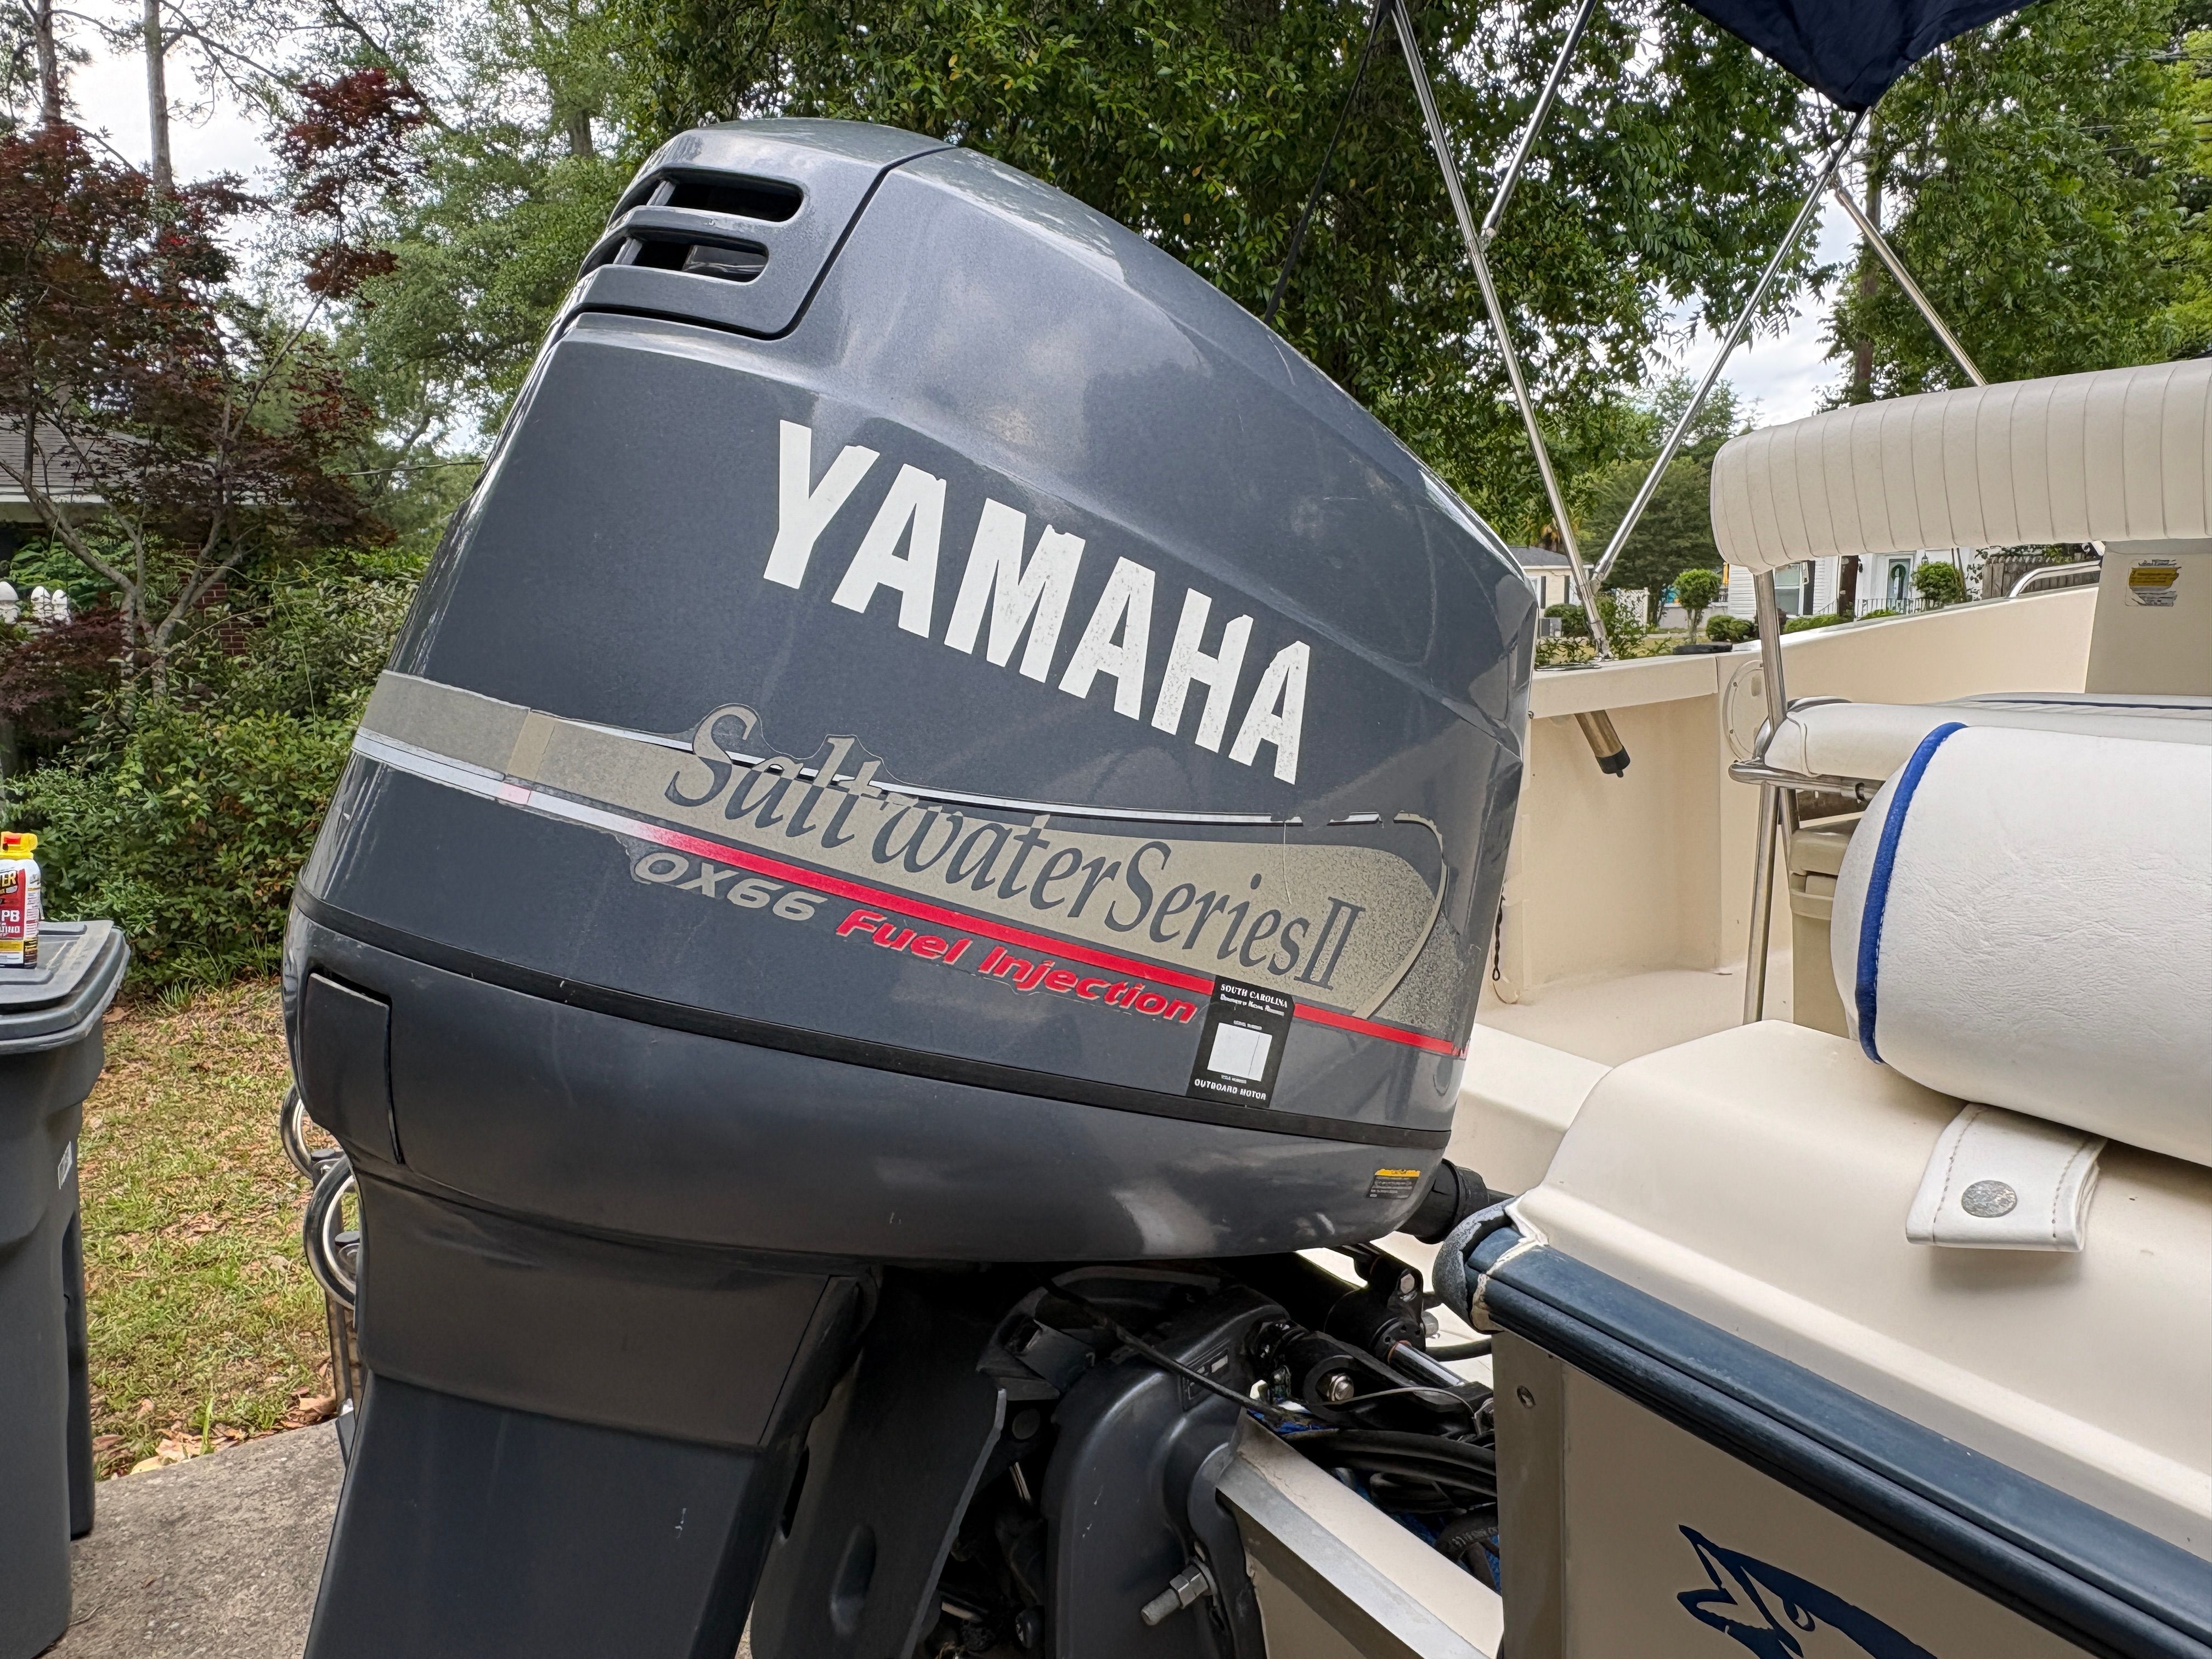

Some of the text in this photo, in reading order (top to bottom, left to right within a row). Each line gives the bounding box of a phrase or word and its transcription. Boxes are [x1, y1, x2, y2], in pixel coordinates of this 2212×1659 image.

[764, 420, 1310, 785] YAMAHA
[635, 852, 827, 921] OX66
[836, 909, 1197, 1023] Fuel Injection
[1220, 984, 1248, 997] SOUTH
[1249, 991, 1288, 1008] CAROLINA
[1194, 1079, 1238, 1094] OUTBOARD
[1240, 1088, 1267, 1101] MOTOR
